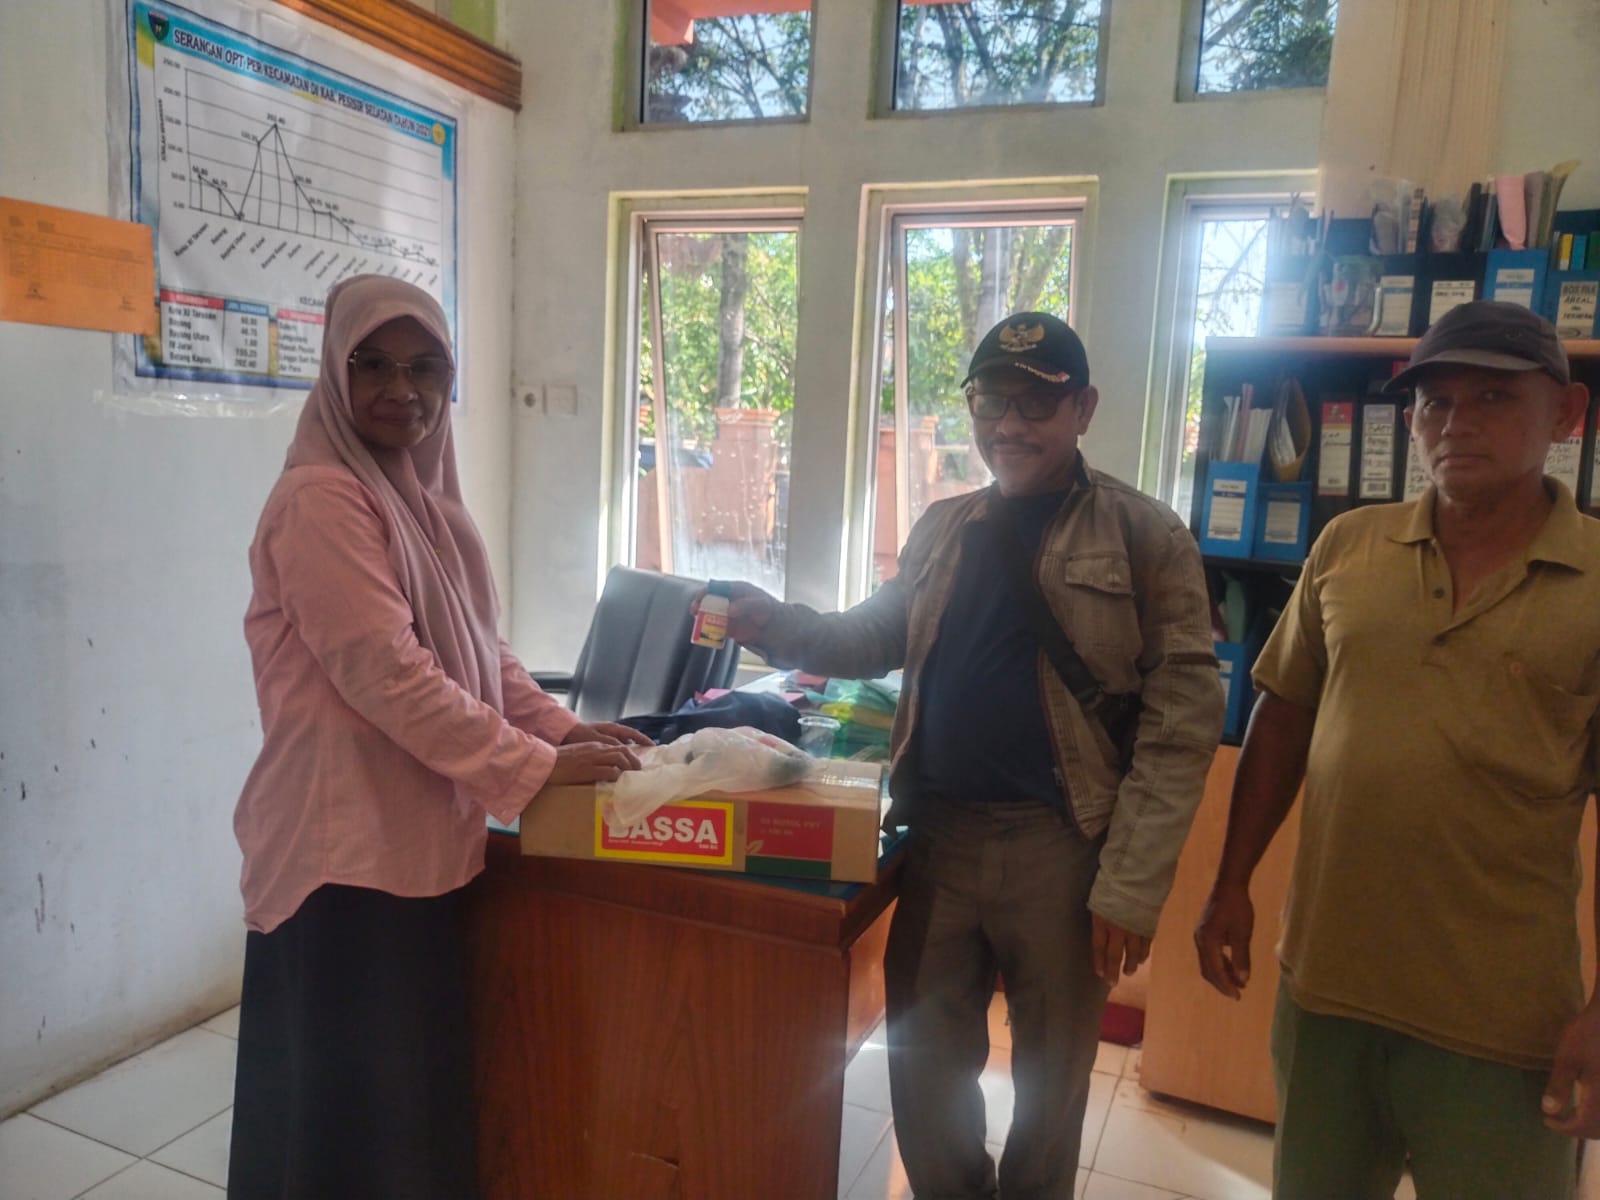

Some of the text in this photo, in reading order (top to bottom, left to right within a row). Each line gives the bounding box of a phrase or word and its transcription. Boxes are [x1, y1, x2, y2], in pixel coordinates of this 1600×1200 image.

[174, 29, 222, 60] SERANGAN
[225, 49, 244, 67] OPT
[246, 57, 261, 73] PER
[264, 64, 309, 93] KECAMATAN
[338, 92, 363, 113] PESISIR
[365, 102, 393, 123] SELATAN
[395, 115, 415, 132] TAHUN
